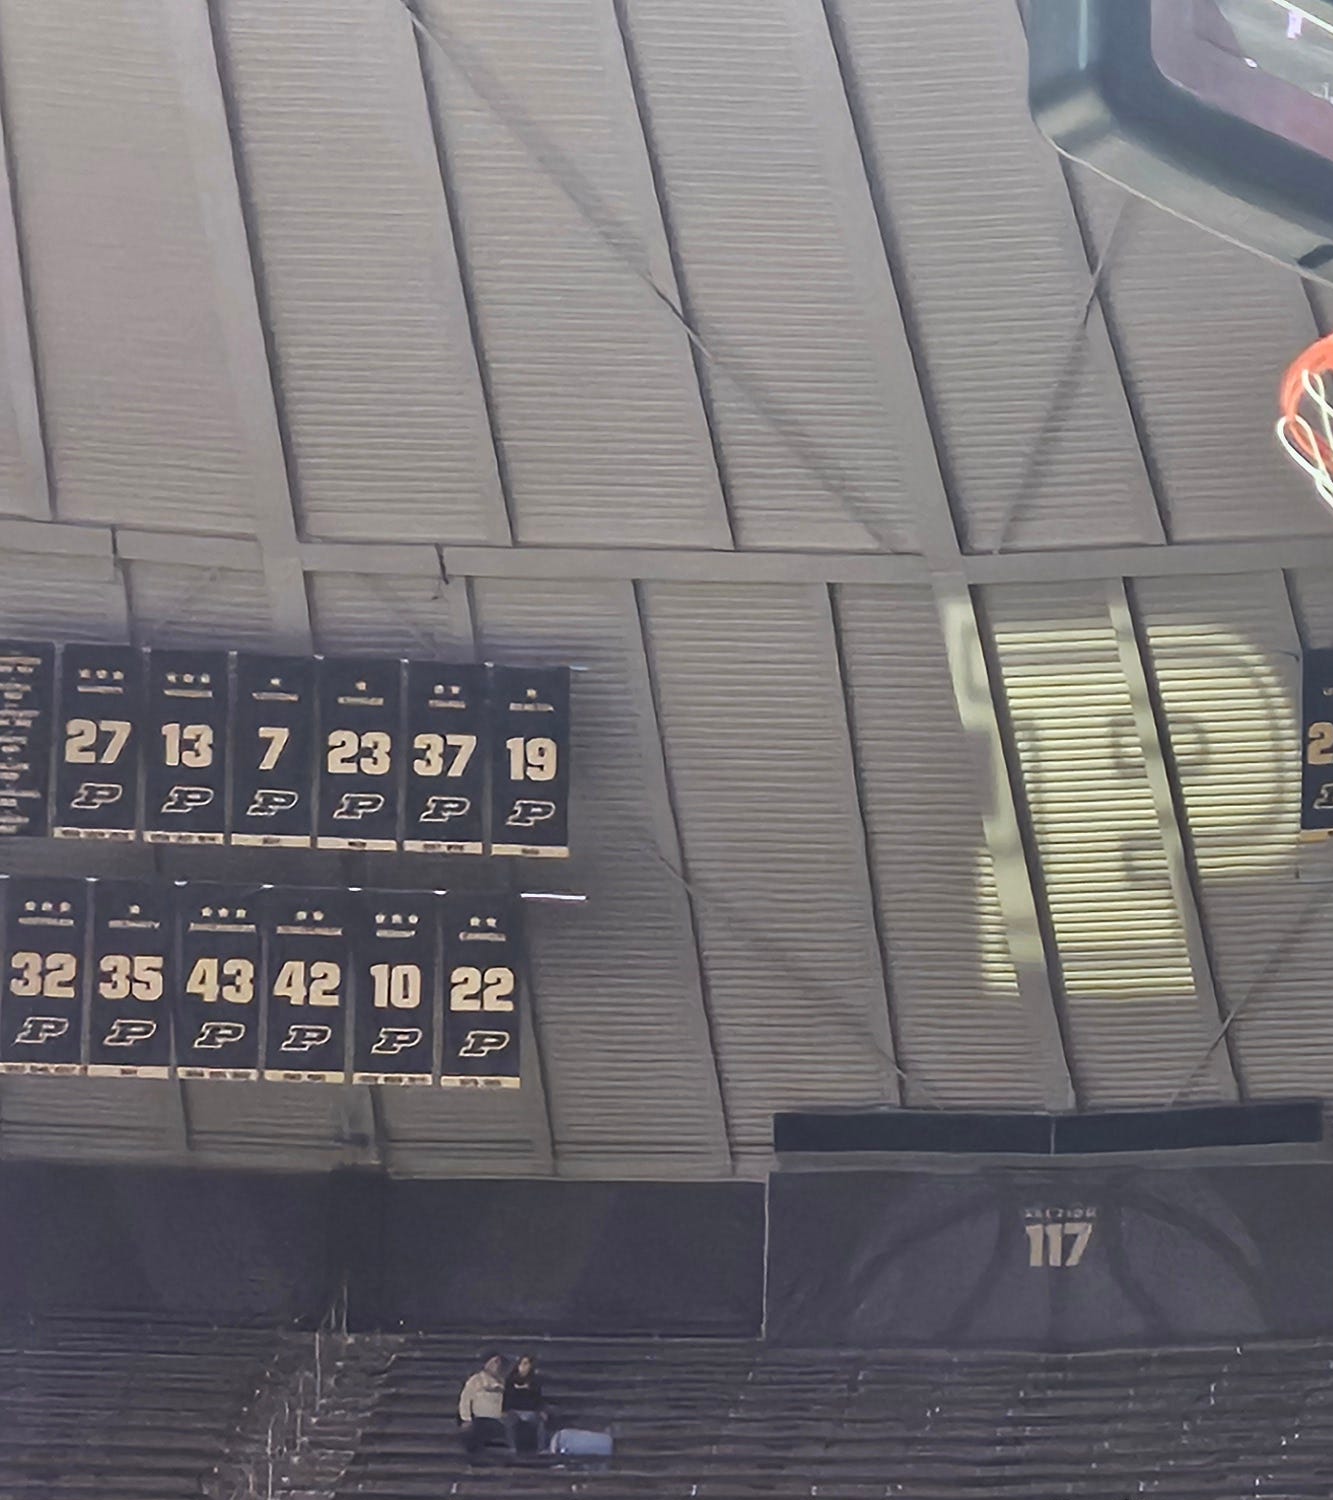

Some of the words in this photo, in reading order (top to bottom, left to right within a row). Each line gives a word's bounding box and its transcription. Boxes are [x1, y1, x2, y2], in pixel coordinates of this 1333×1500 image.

[65, 718, 132, 764] 27
[161, 722, 214, 767] 13
[258, 727, 290, 770] 7
[327, 730, 392, 775] 23
[413, 733, 478, 778] 37
[505, 737, 558, 781] 19
[9, 952, 77, 998] 32
[99, 954, 165, 1001] 35
[185, 957, 255, 1004] 43
[273, 961, 342, 1006] 42
[369, 964, 421, 1009] 10
[450, 967, 515, 1012] 22
[1025, 1222, 1093, 1267] 117
